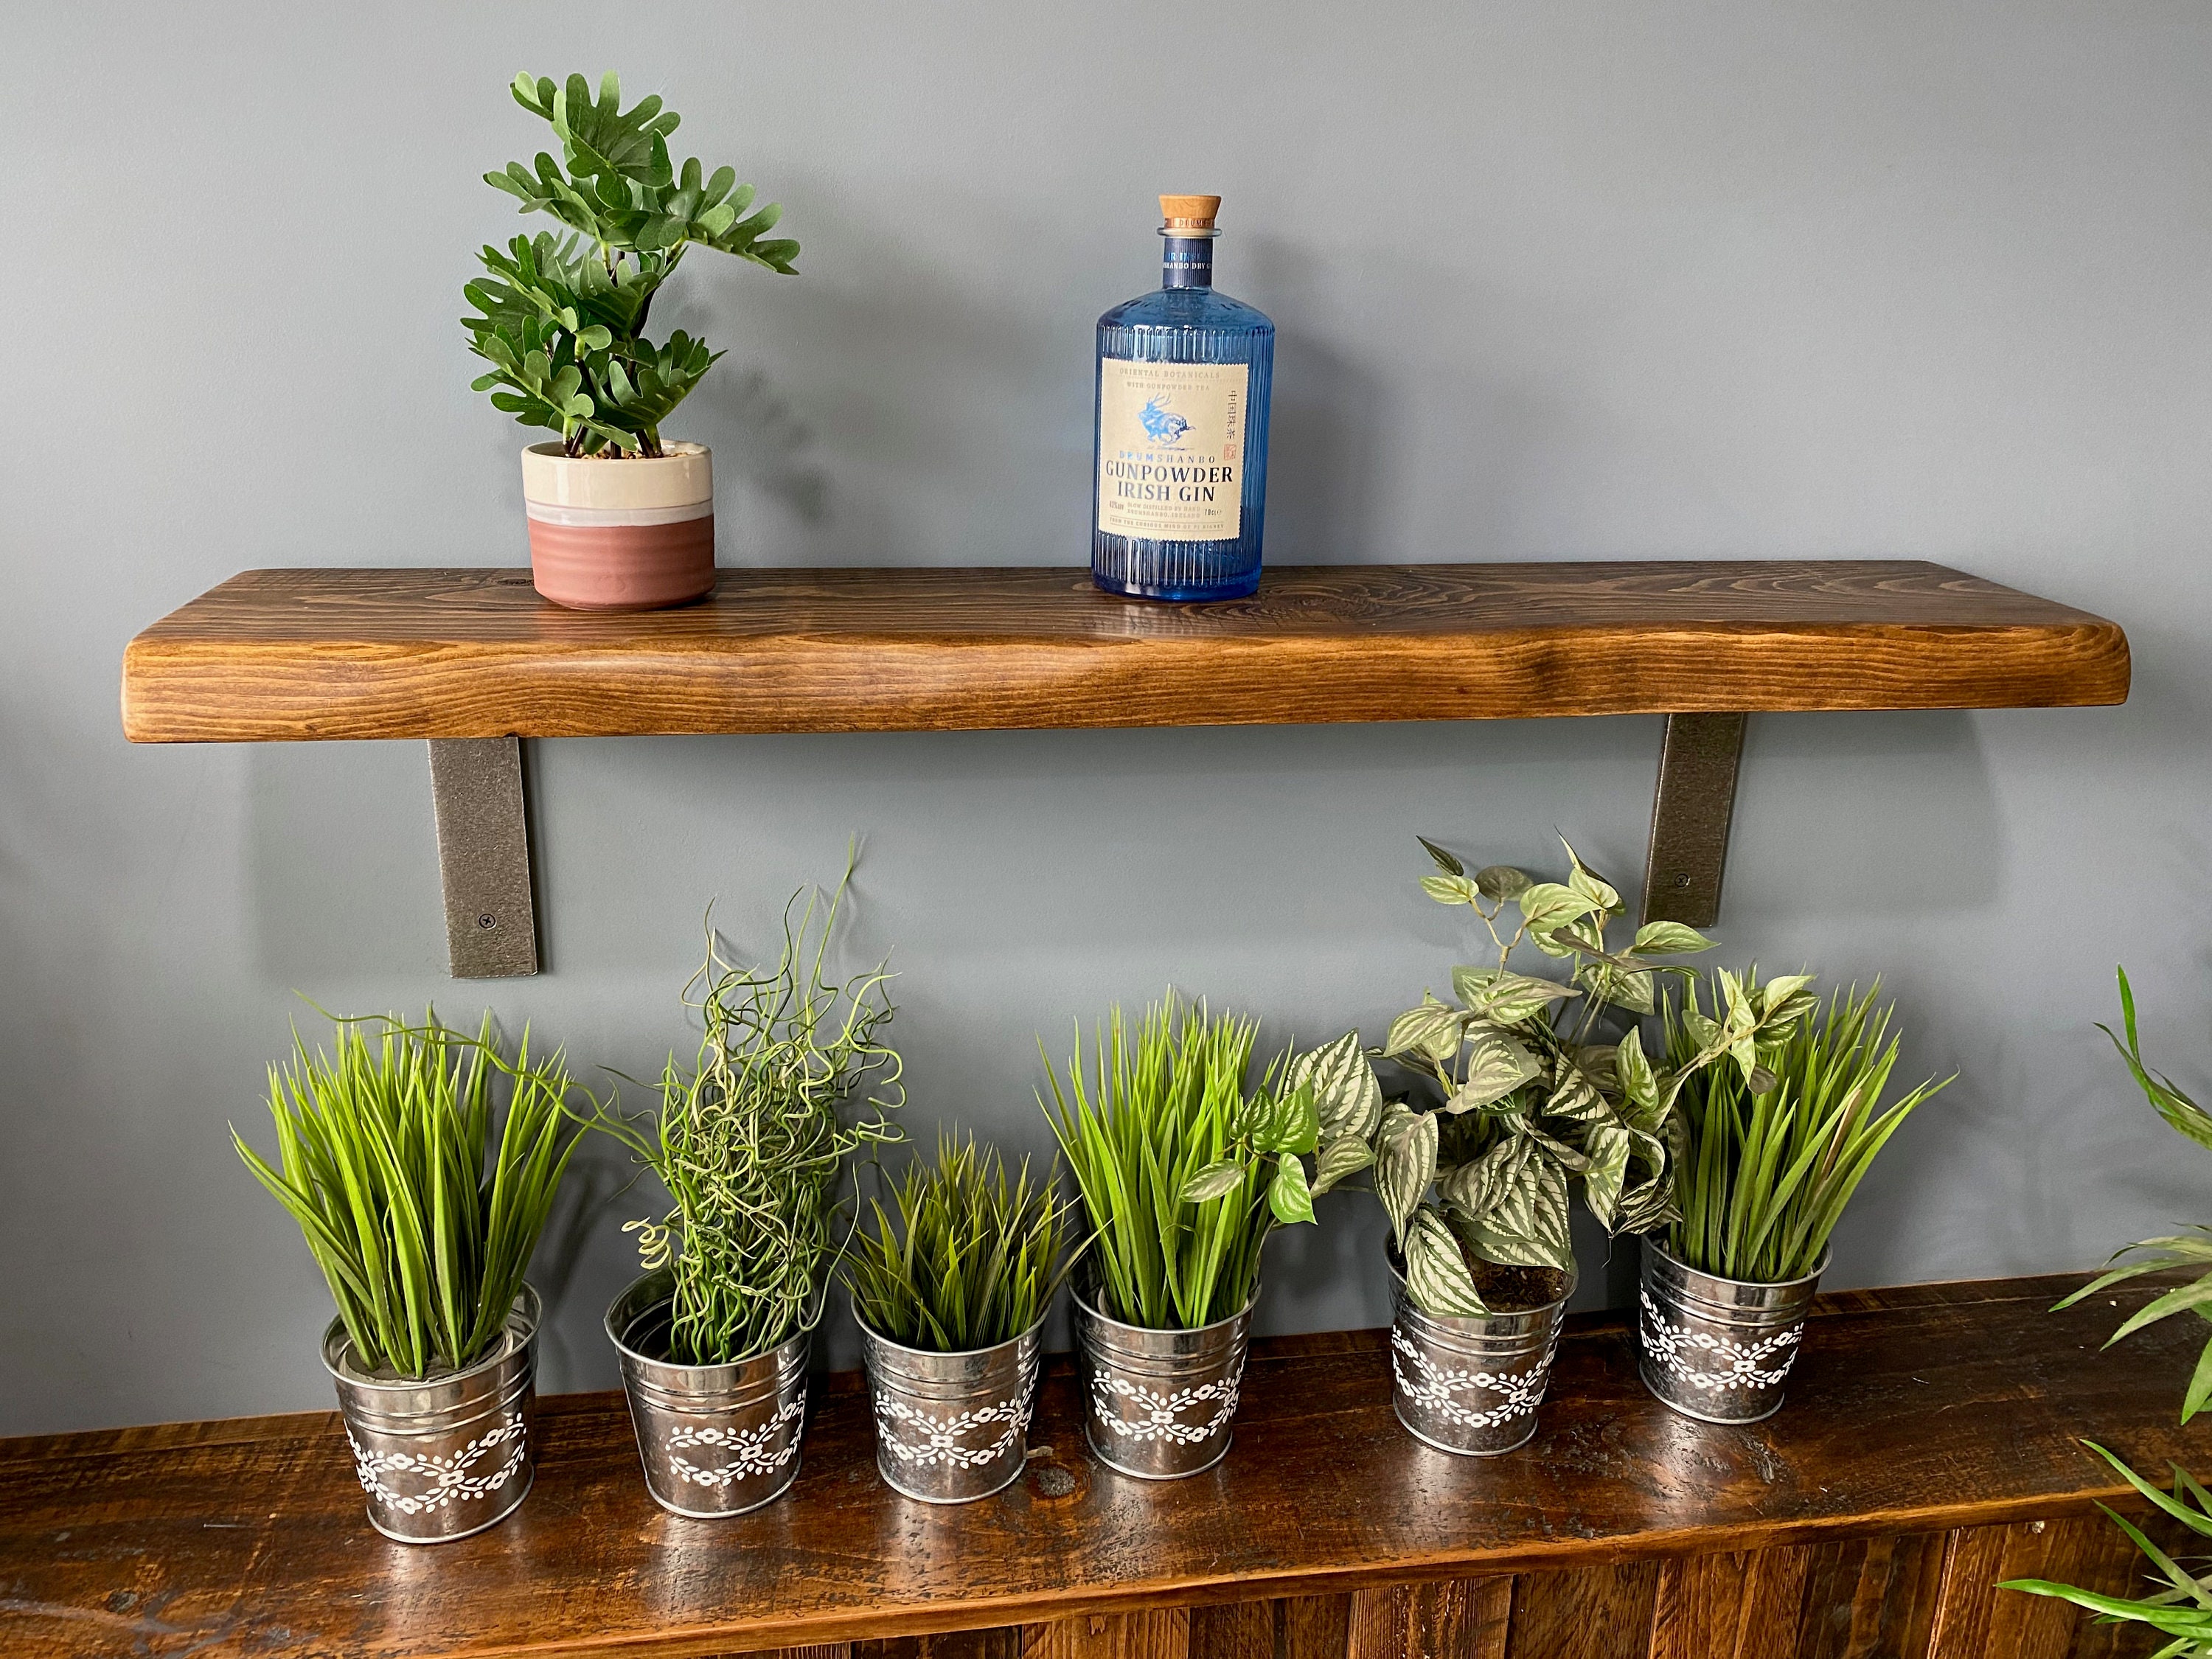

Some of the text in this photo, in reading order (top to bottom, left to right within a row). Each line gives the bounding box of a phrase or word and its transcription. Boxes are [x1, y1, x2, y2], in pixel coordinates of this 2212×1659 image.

[1120, 368, 1220, 379] ORIENTAL BOTANICALS
[1119, 451, 1215, 464] DRUMSHANBO
[1106, 460, 1233, 483] GUNPOWDER
[1117, 481, 1215, 502] IRISH GIN
